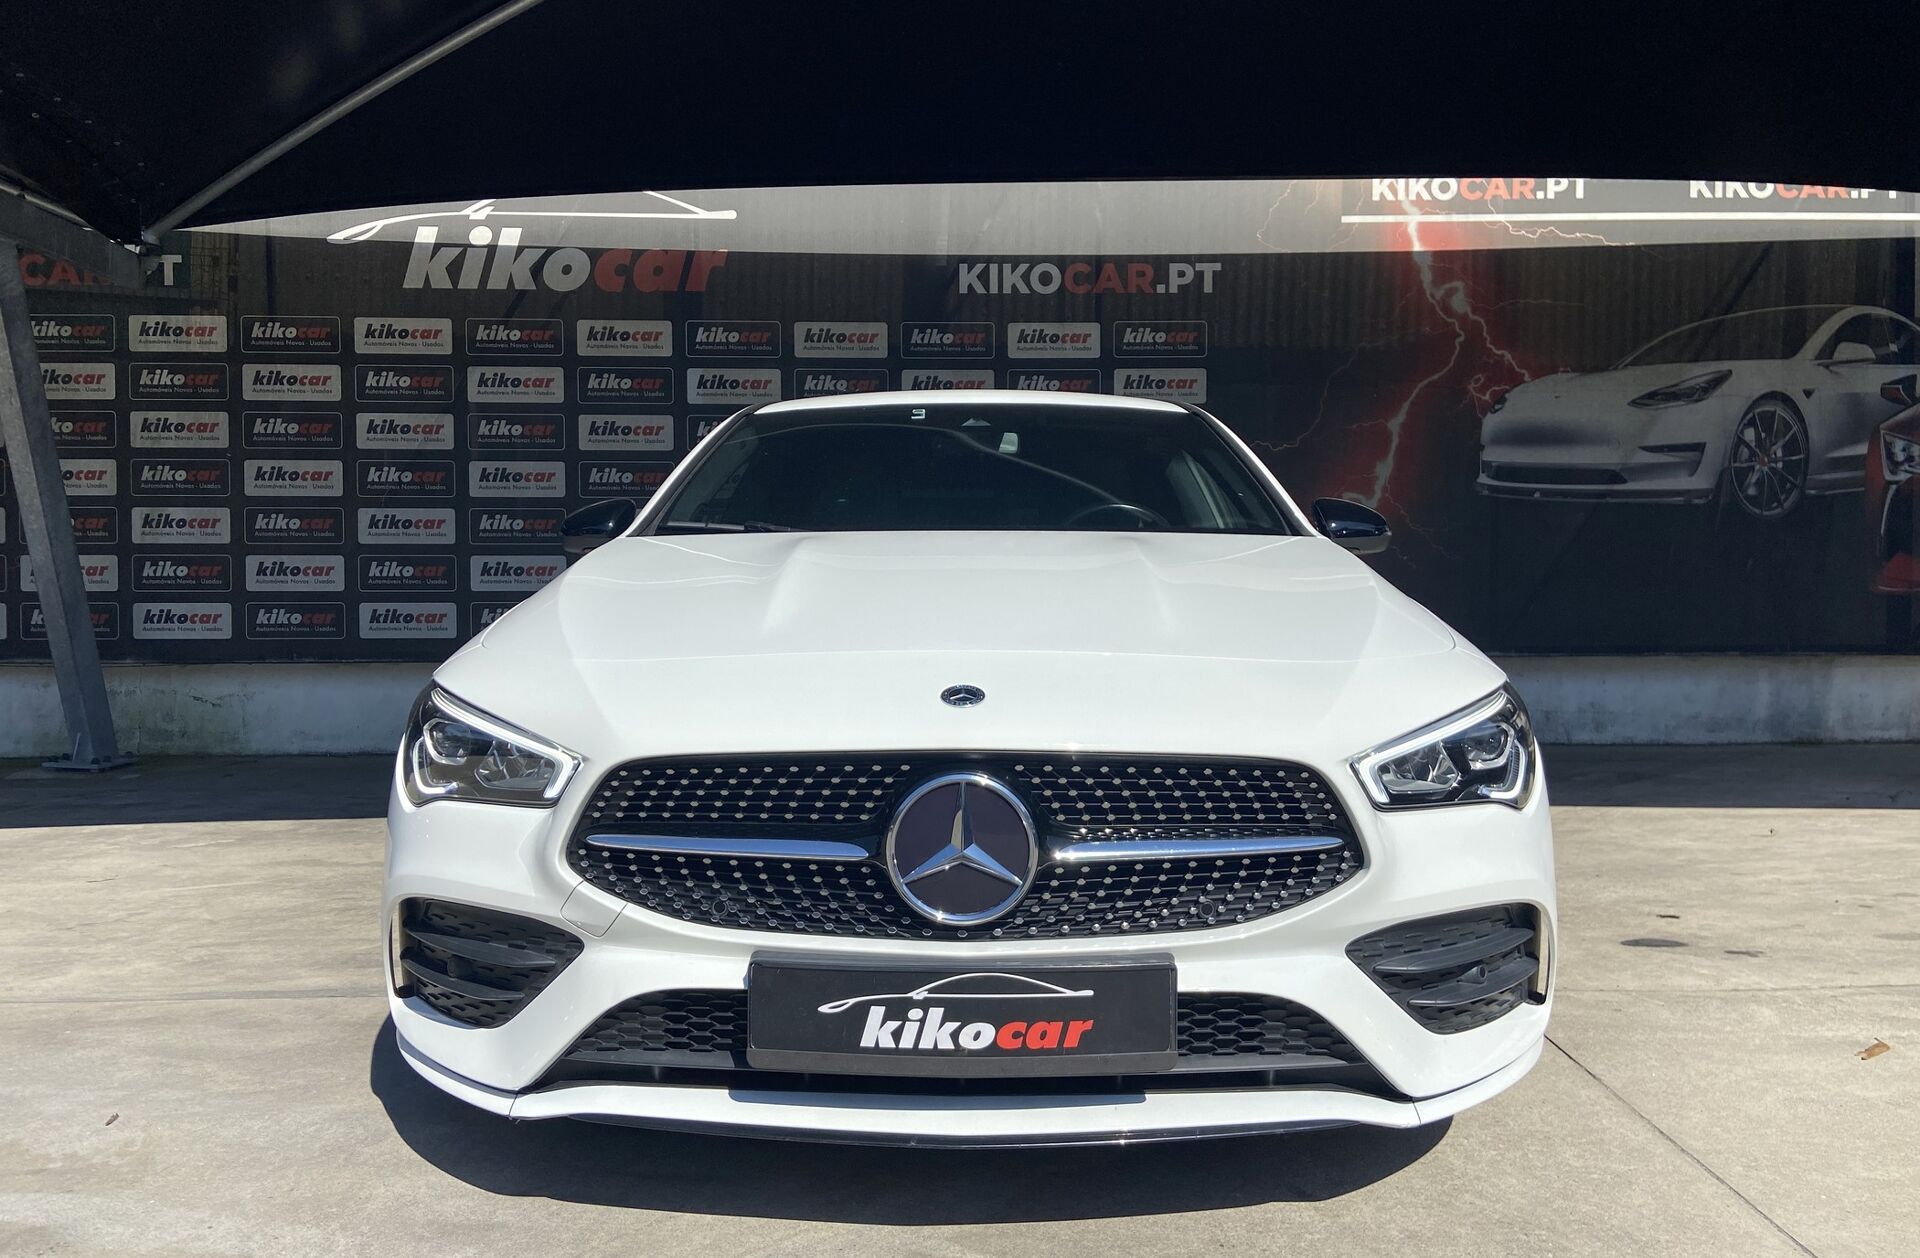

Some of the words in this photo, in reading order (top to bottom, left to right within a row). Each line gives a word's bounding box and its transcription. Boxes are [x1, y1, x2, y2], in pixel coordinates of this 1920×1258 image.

[1372, 178, 1585, 200] KIKOCAR.PT
[402, 226, 728, 292] kikocar
[959, 262, 1222, 294] KIKOCAR.PT
[139, 321, 217, 337] kikocar
[251, 322, 331, 338] kikocar
[365, 324, 443, 339] kikocar
[475, 325, 554, 340] kikocar
[587, 326, 664, 341] kikocar
[696, 327, 772, 342] kikocar
[804, 328, 879, 343] kikocar
[911, 329, 986, 344] kikocar
[1017, 329, 1091, 343] kikocar
[1123, 328, 1198, 342] kikocar
[43, 368, 106, 384] ikocar
[140, 369, 218, 385] kikocar
[252, 370, 331, 386] kikocar
[365, 371, 444, 387] kikocar
[476, 373, 554, 388] kikocar
[587, 373, 665, 389] kikocar
[696, 375, 772, 389] kikocar
[804, 375, 880, 390] kikocar
[911, 376, 985, 389] kikocar
[1018, 376, 1092, 390] kikocar
[1123, 375, 1197, 389] kikocar
[51, 416, 107, 432] kocar
[140, 418, 219, 433] kikocar
[253, 418, 333, 434] kikocar
[366, 419, 444, 434] kikocar
[477, 420, 556, 435] kikocar
[588, 421, 666, 436] kikocar
[62, 469, 108, 481] ocar
[141, 466, 220, 481] kikocar
[253, 466, 333, 481] kikocar
[367, 467, 445, 482] kikocar
[478, 467, 556, 482] kikocar
[589, 468, 667, 483] kikocar
[142, 513, 220, 529] kikocar
[254, 514, 334, 529] kikocar
[368, 514, 445, 529] kikocar
[479, 515, 557, 529] kikocar
[142, 561, 222, 576] kikocar
[255, 561, 334, 576] kikocar
[368, 562, 447, 576] kikocar
[480, 562, 557, 576] kikocar
[143, 609, 222, 624] kikocar
[256, 609, 336, 624] kikocar
[369, 609, 447, 624] kikocar
[860, 1006, 1094, 1050] kikocar
